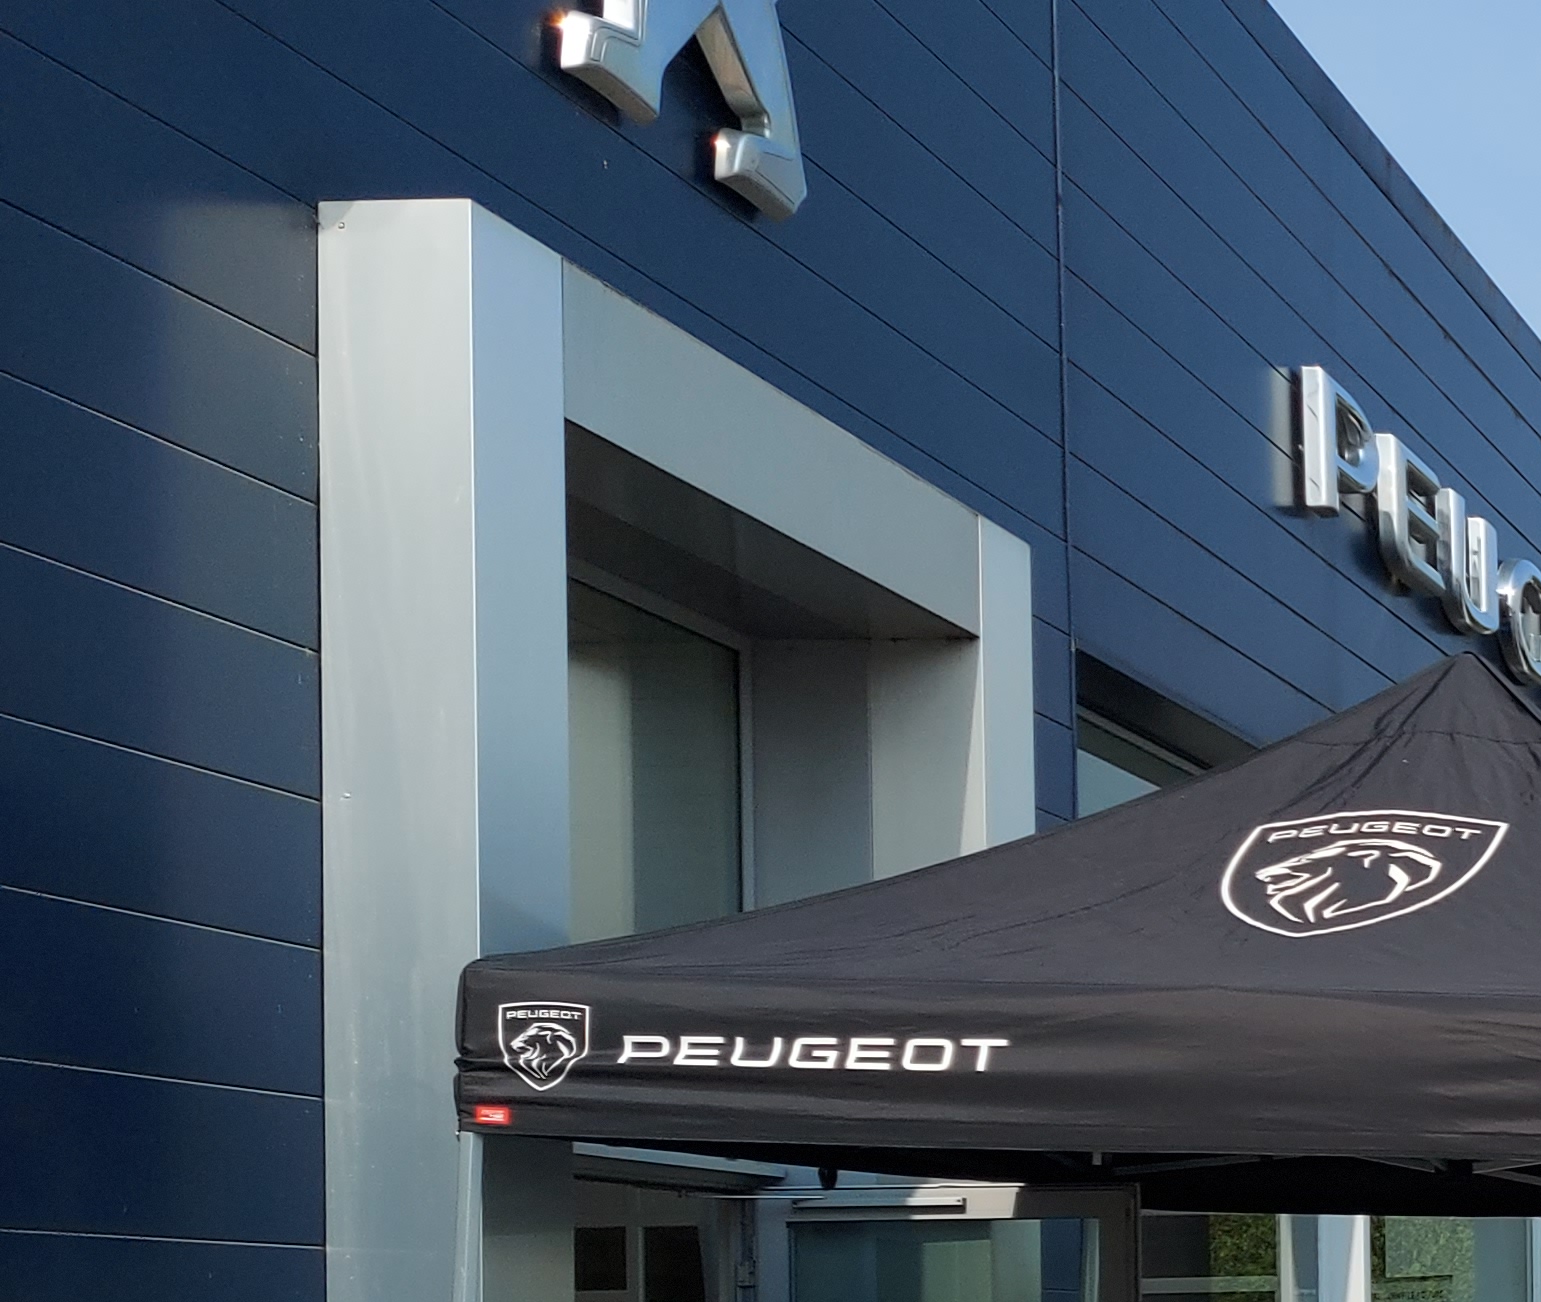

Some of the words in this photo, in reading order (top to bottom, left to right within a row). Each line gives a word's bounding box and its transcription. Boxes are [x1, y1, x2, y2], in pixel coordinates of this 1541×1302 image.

[1267, 822, 1482, 843] PEUGEOT
[506, 1009, 582, 1020] PEUGEOT
[616, 1035, 1010, 1072] PEUGEOT
